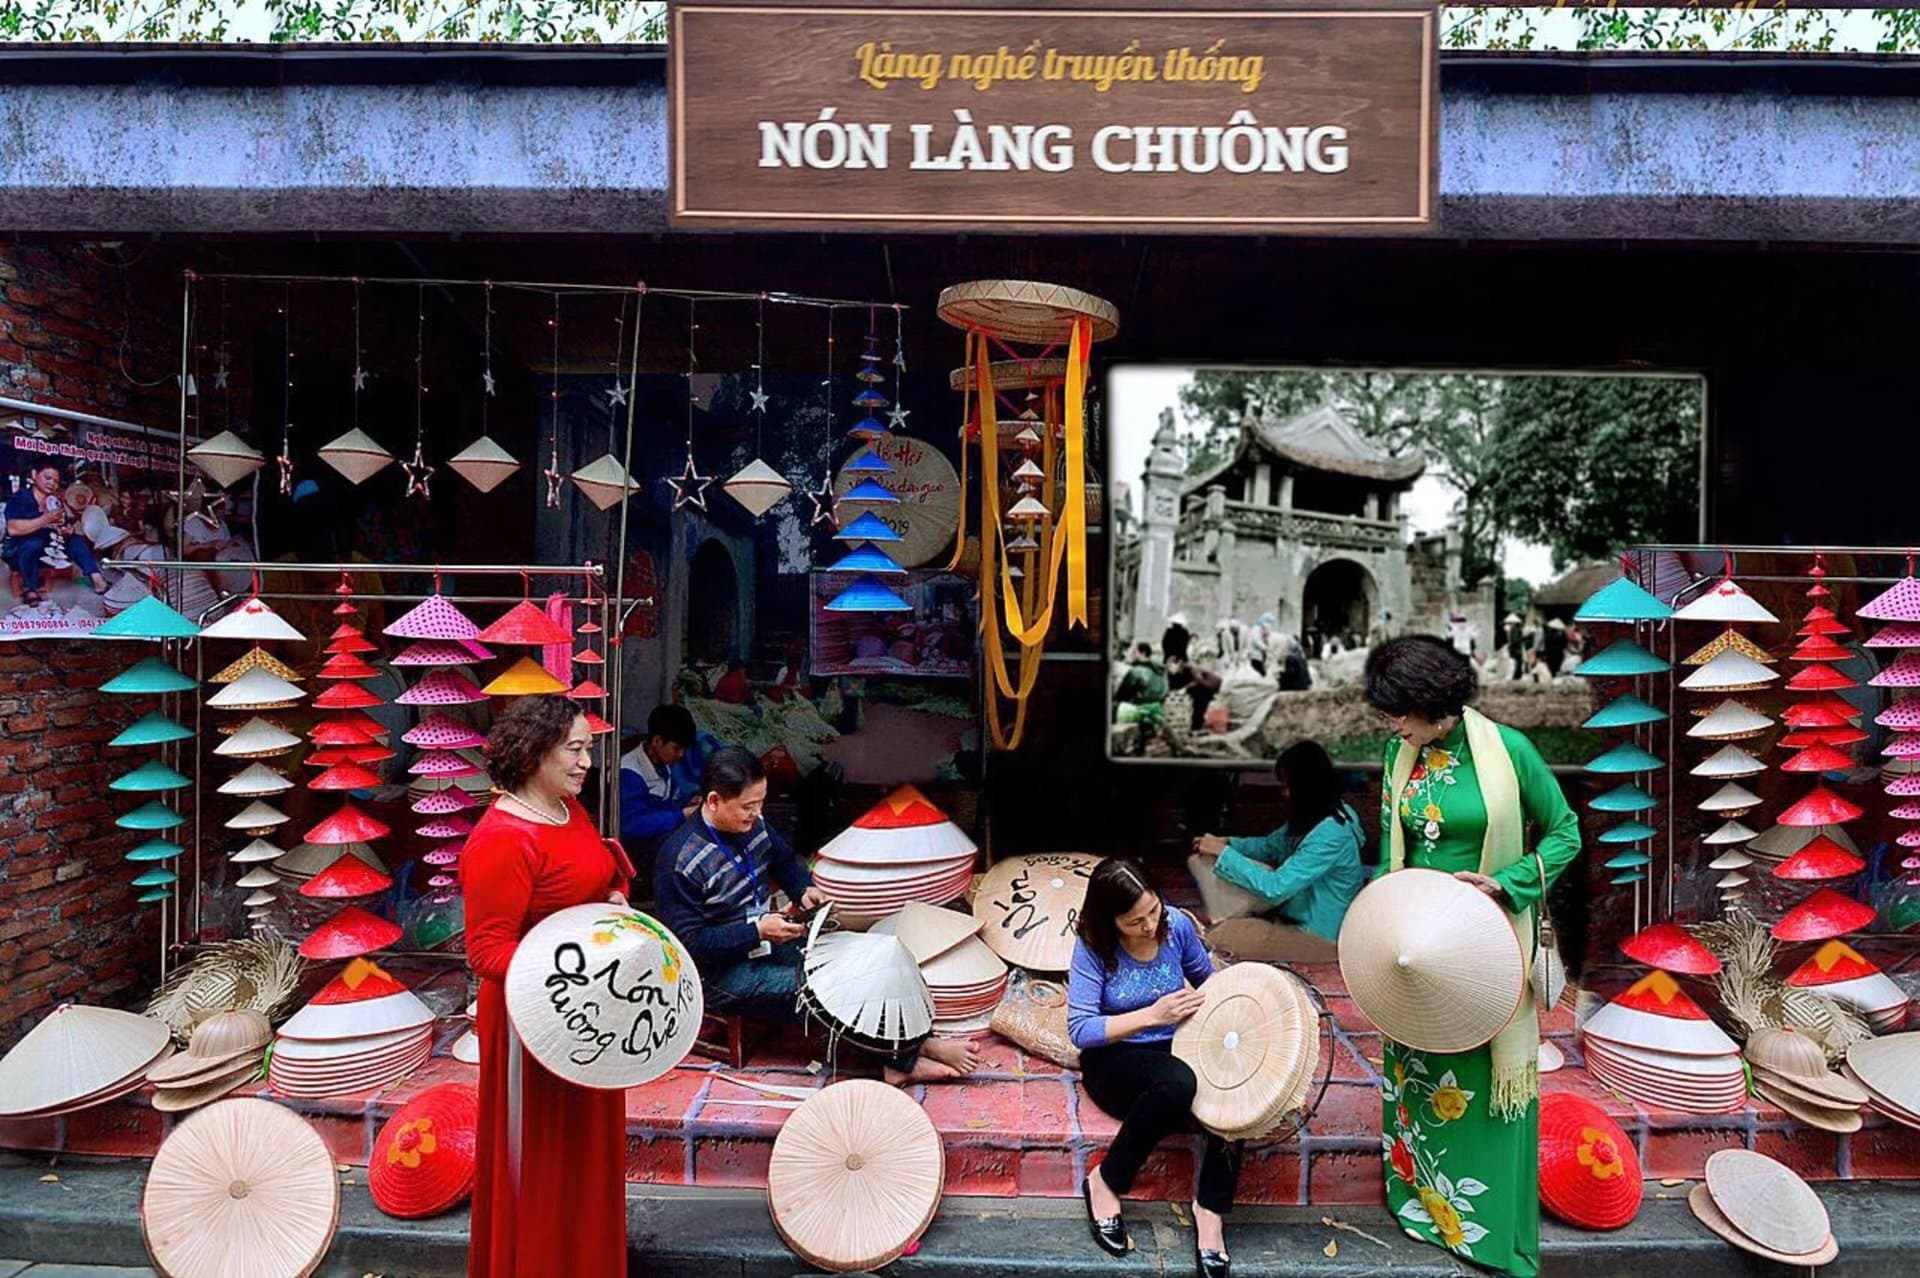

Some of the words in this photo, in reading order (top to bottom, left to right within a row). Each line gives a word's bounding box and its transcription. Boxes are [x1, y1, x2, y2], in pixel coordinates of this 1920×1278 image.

[855, 40, 944, 90] Làng
[1162, 38, 1265, 92] thống
[758, 107, 891, 169] NÓN
[909, 109, 1075, 172] LÀNG
[1092, 110, 1350, 173] CHUÔNG
[594, 959, 669, 1006] Nón
[622, 1008, 679, 1063] Quê
